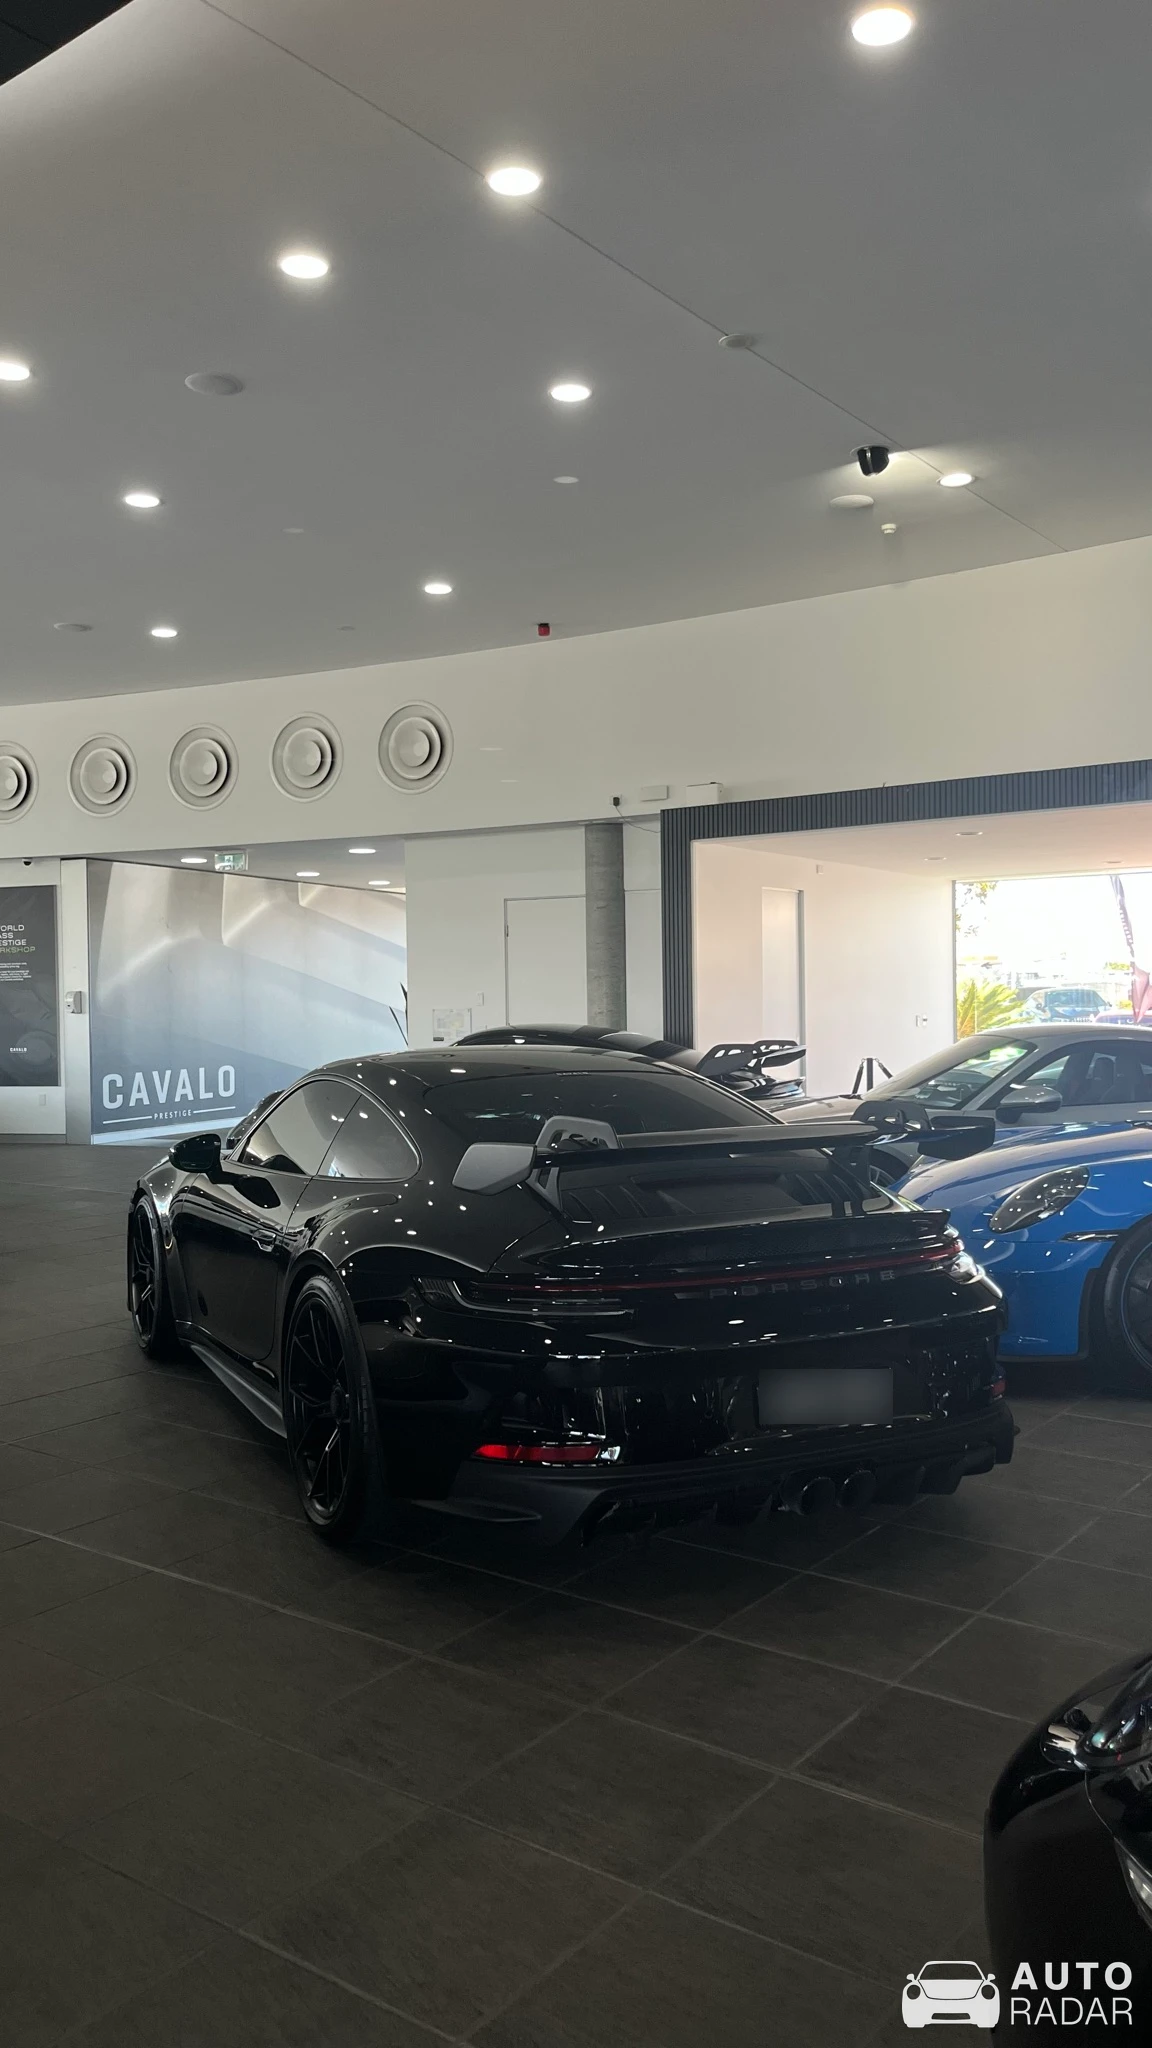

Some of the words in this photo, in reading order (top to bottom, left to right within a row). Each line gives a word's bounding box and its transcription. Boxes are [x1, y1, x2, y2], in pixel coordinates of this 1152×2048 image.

[0, 924, 25, 932] ORLD
[102, 1065, 236, 1109] CAVALO
[153, 1109, 192, 1120] PRESTIGE
[709, 1269, 896, 1299] PORSCHE
